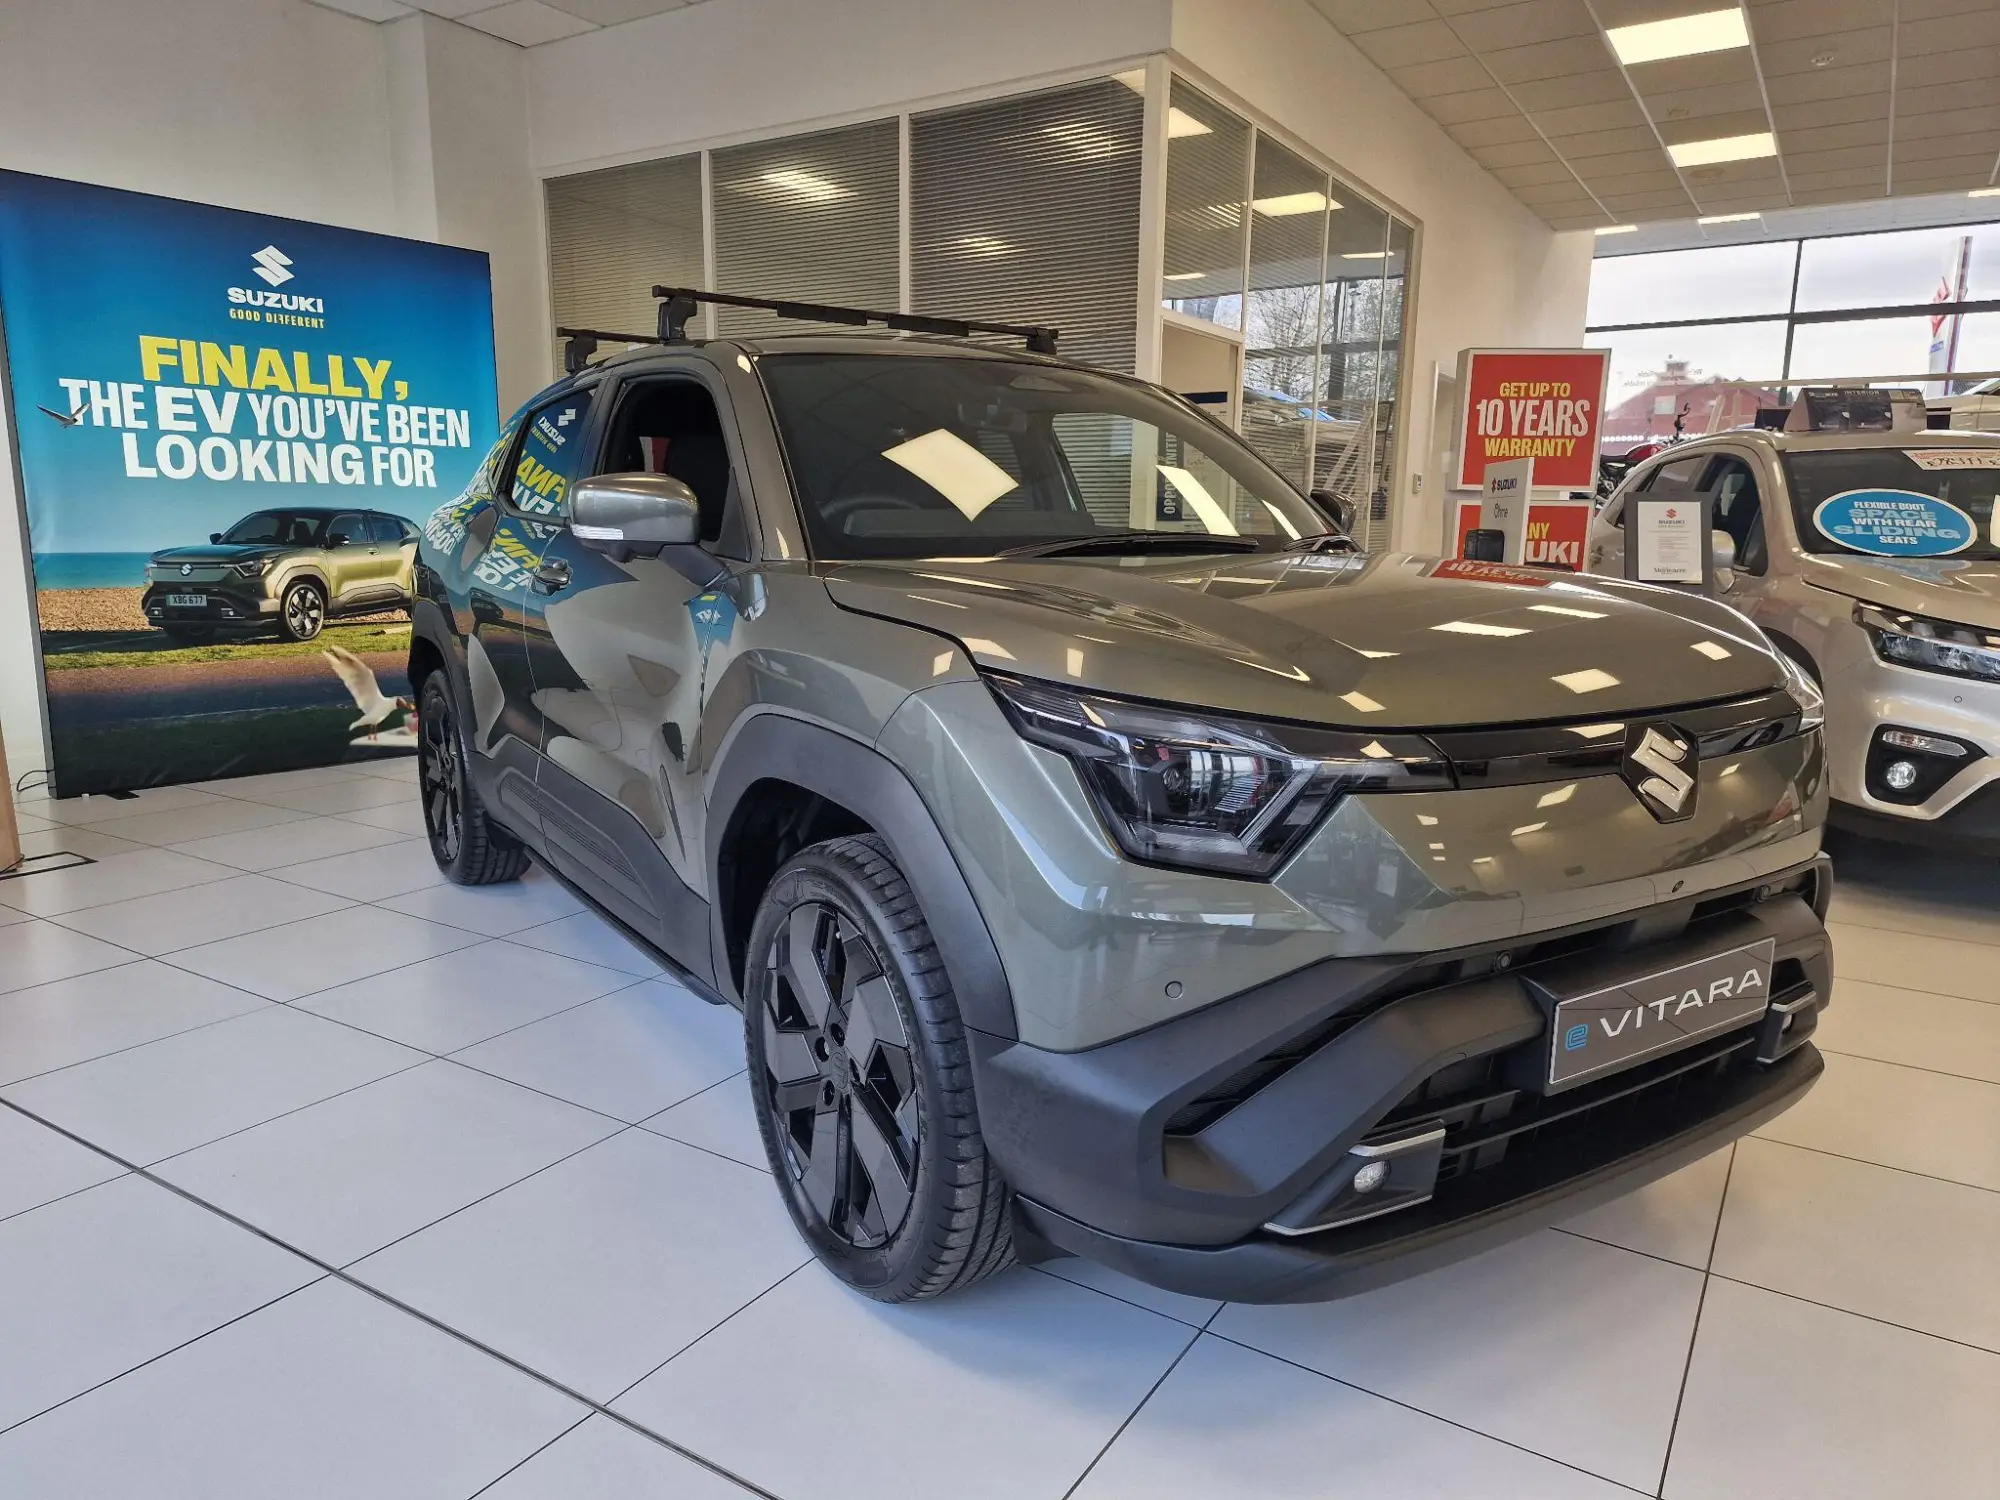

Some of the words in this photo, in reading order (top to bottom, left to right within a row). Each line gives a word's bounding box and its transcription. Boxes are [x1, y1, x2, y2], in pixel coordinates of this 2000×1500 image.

[227, 286, 324, 314] SUZUKI
[229, 308, 261, 322] GOOD
[265, 312, 325, 329] DIFFERENT
[139, 334, 408, 401] FINALLY,
[1499, 382, 1526, 398] GET
[1529, 382, 1550, 397] UP
[1550, 382, 1571, 397] TO
[58, 377, 149, 430] THE
[155, 386, 240, 435] EV
[246, 394, 381, 444] YOU'VE
[387, 404, 471, 449] BEEN
[1475, 399, 1504, 437] 10
[1509, 399, 1591, 438] YEARS
[1484, 438, 1576, 457] WARRANTY
[121, 432, 367, 486] LOOKING
[371, 446, 438, 488] FOR
[1497, 478, 1518, 491] SUZUKI
[1848, 508, 1938, 521] SPACE
[1853, 501, 1898, 510] FLEXIBLE
[1899, 502, 1926, 512] BOOT
[1527, 522, 1550, 539] NY
[1833, 524, 1961, 539] SLIDING
[1852, 518, 1894, 527] WITH
[1895, 519, 1937, 528] REAR
[1879, 535, 1918, 545] SEATS
[1600, 968, 1763, 1038] VITARA
